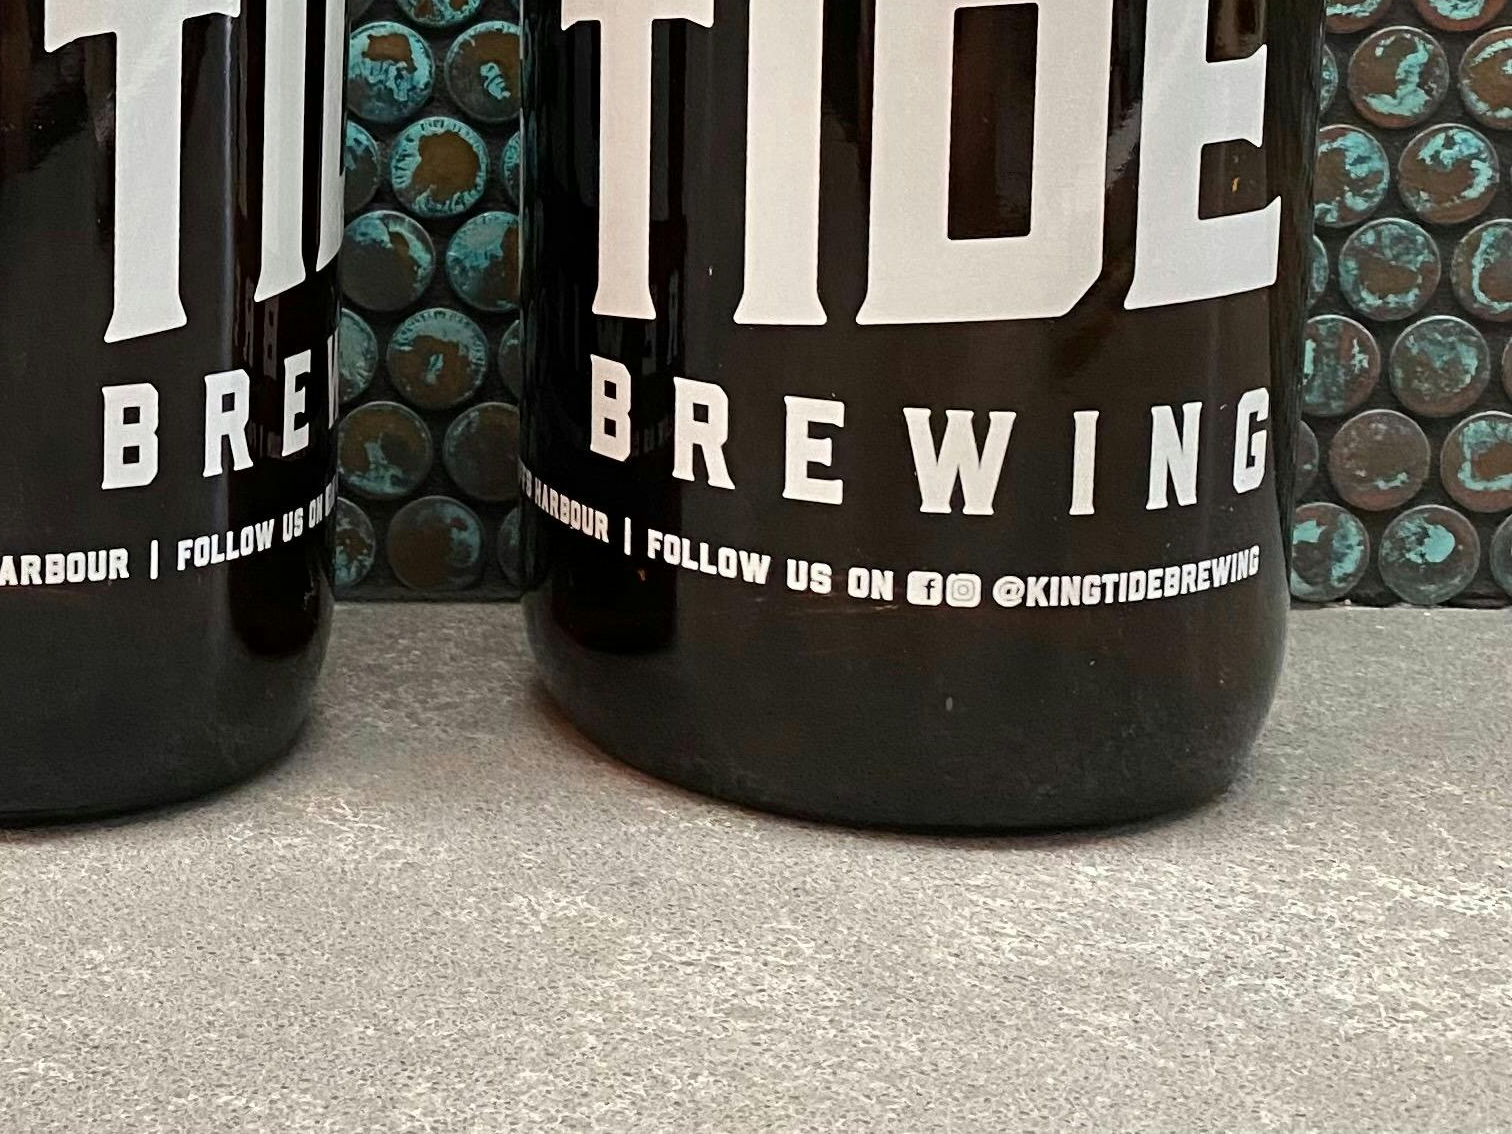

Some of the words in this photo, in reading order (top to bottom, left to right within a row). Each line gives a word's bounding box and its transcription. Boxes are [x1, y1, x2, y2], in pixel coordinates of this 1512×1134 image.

[590, 354, 1269, 516] BREWING
[176, 518, 275, 571] FOLLOW
[282, 507, 304, 543] US
[308, 493, 323, 529] ON
[534, 477, 610, 544] HARBOUR
[647, 528, 772, 585] FOLLOW
[786, 558, 833, 595] US
[847, 567, 894, 601] ON
[992, 544, 1260, 608] @KINGTIDEBREWING
